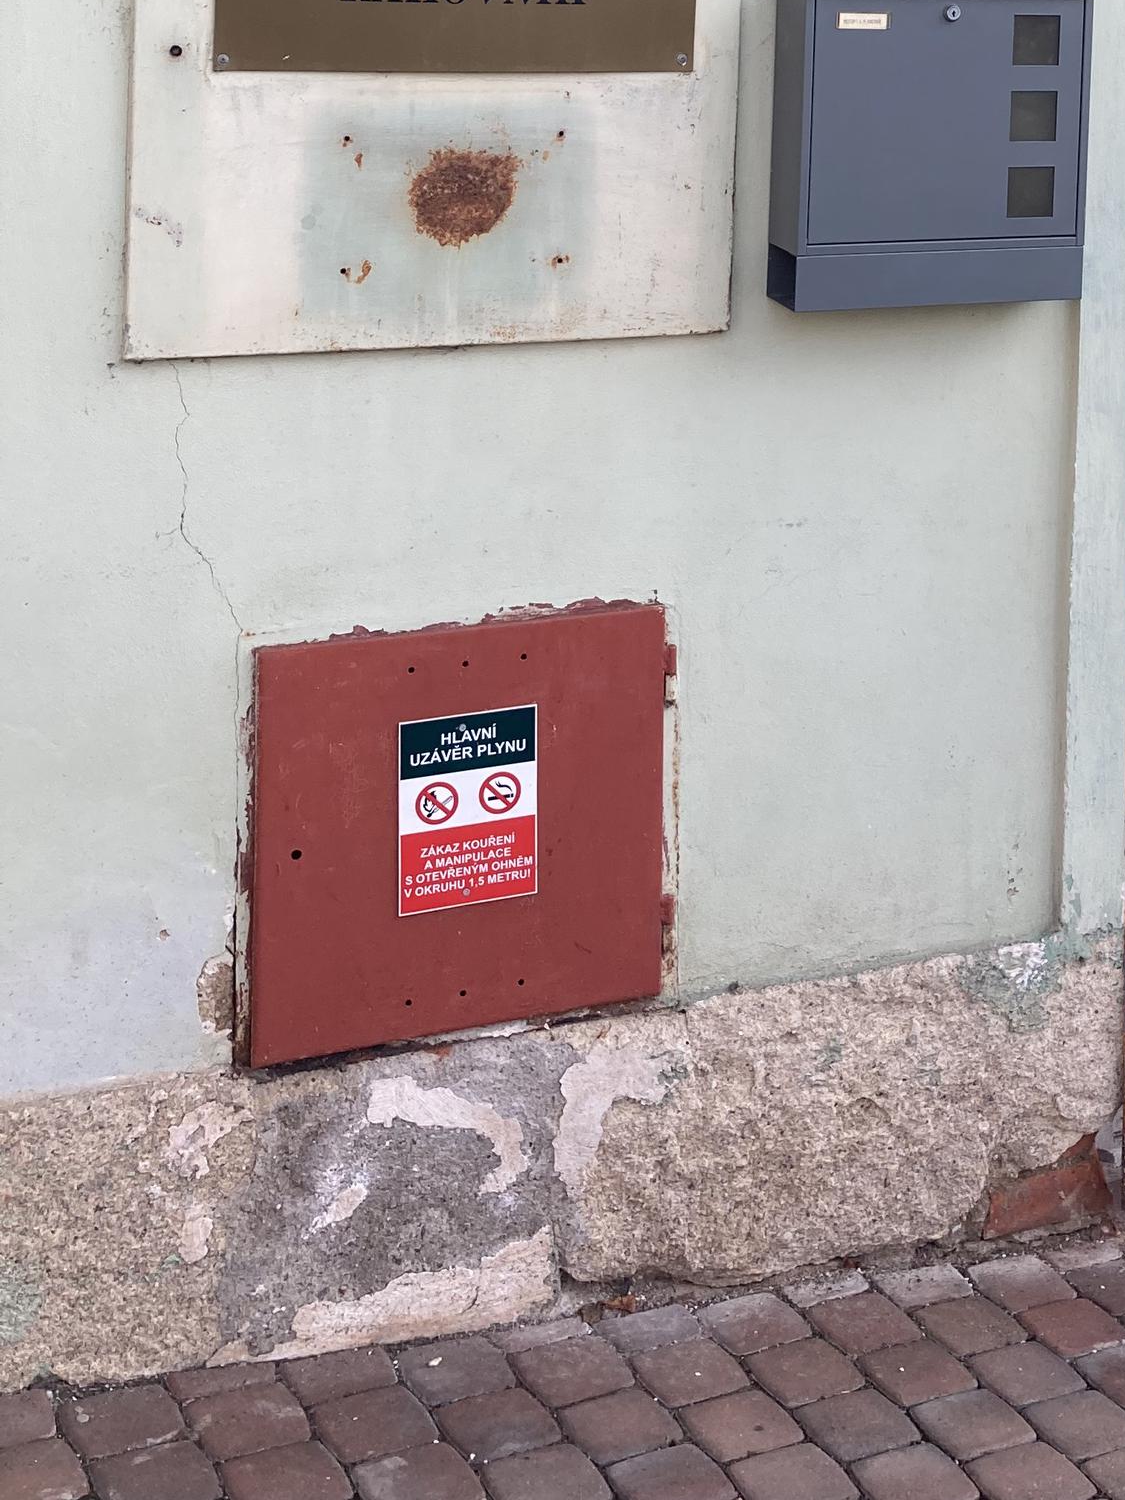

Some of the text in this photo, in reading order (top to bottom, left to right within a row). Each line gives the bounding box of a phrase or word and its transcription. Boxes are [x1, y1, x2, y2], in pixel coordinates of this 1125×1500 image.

[441, 723, 497, 746] HLAVNÍ
[410, 738, 527, 767] UZÁVĚR PLYNU
[420, 832, 515, 858] ZÁKAZ KOUŘENÍ
[424, 847, 511, 870] A MANIPULACE
[404, 868, 531, 898] V OKRUHU 1,5 METRU!
[405, 855, 533, 885] S OTEVŘENÝM OHNĚM
